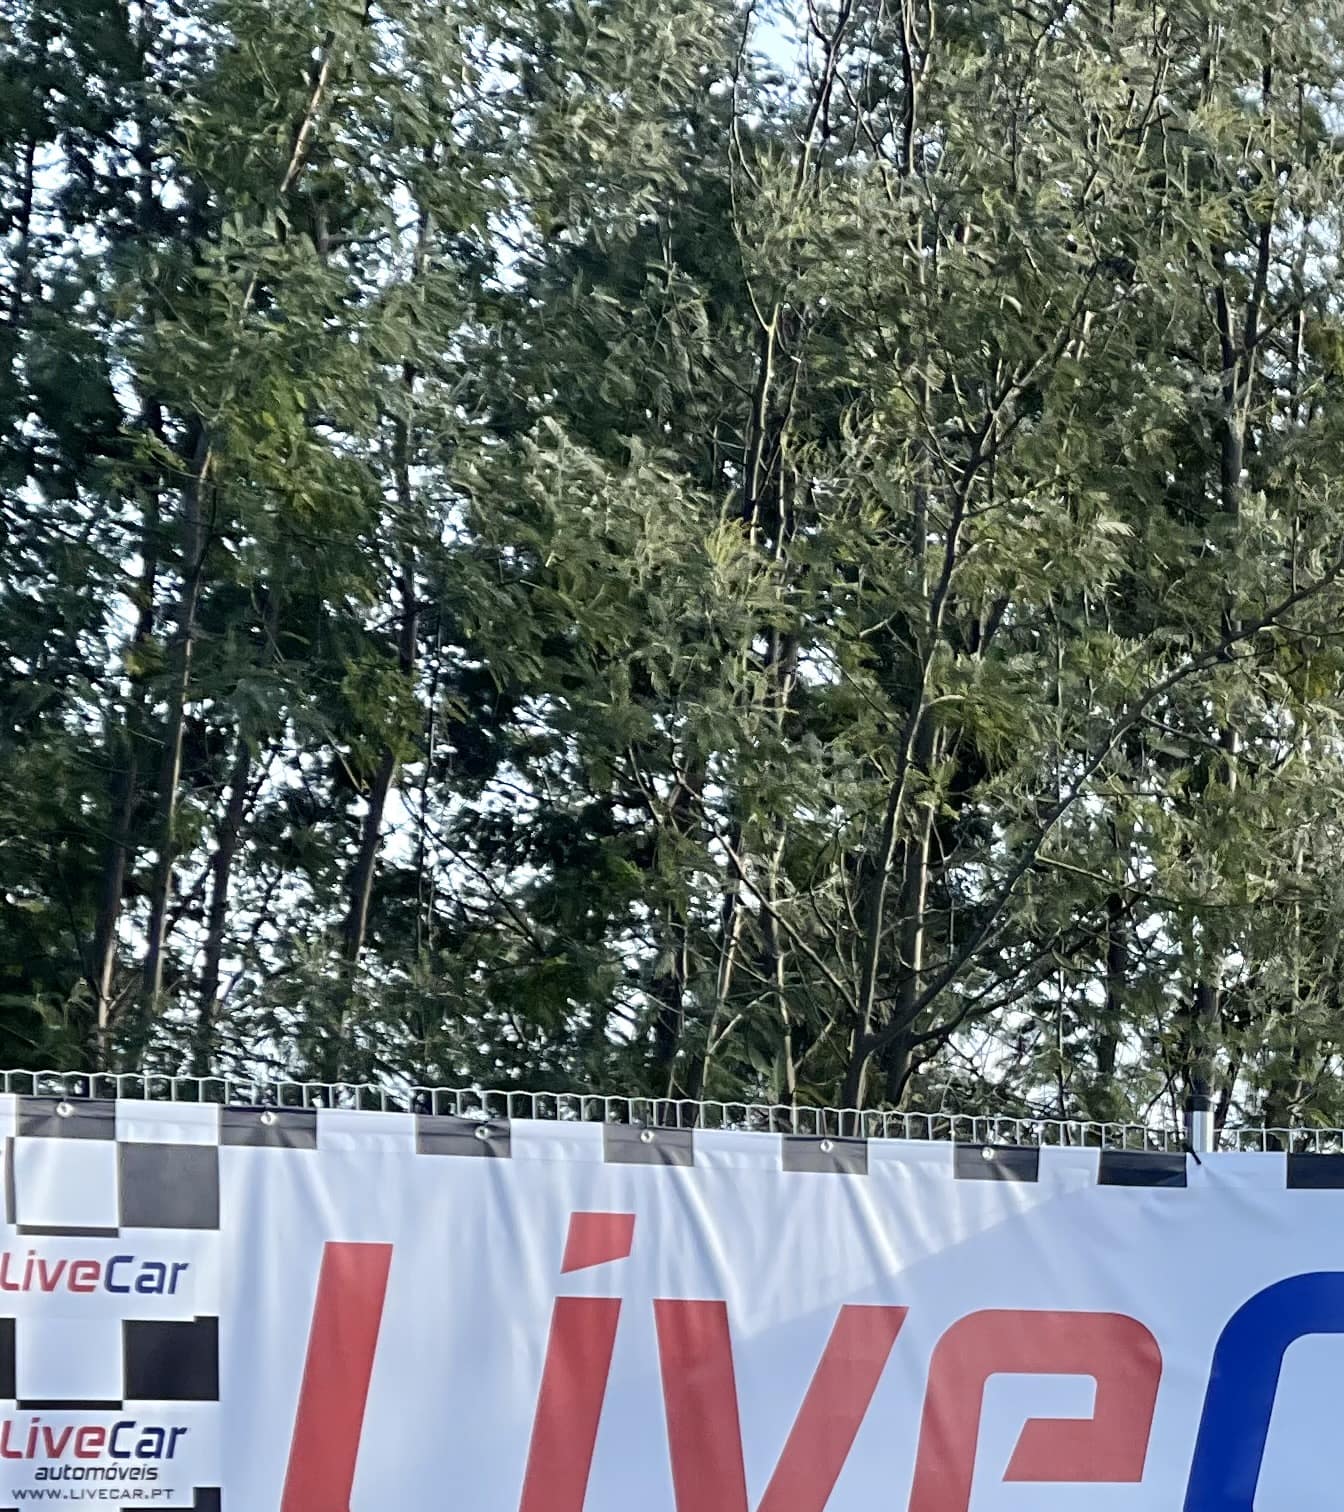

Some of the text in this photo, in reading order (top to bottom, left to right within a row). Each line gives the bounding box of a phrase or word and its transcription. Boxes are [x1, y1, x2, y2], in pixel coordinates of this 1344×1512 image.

[0, 1250, 190, 1294] LiveCar
[0, 1418, 187, 1459] LiveCar
[35, 1463, 158, 1480] automóveis
[12, 1489, 174, 1499] WWW.LIVECAR.PT
